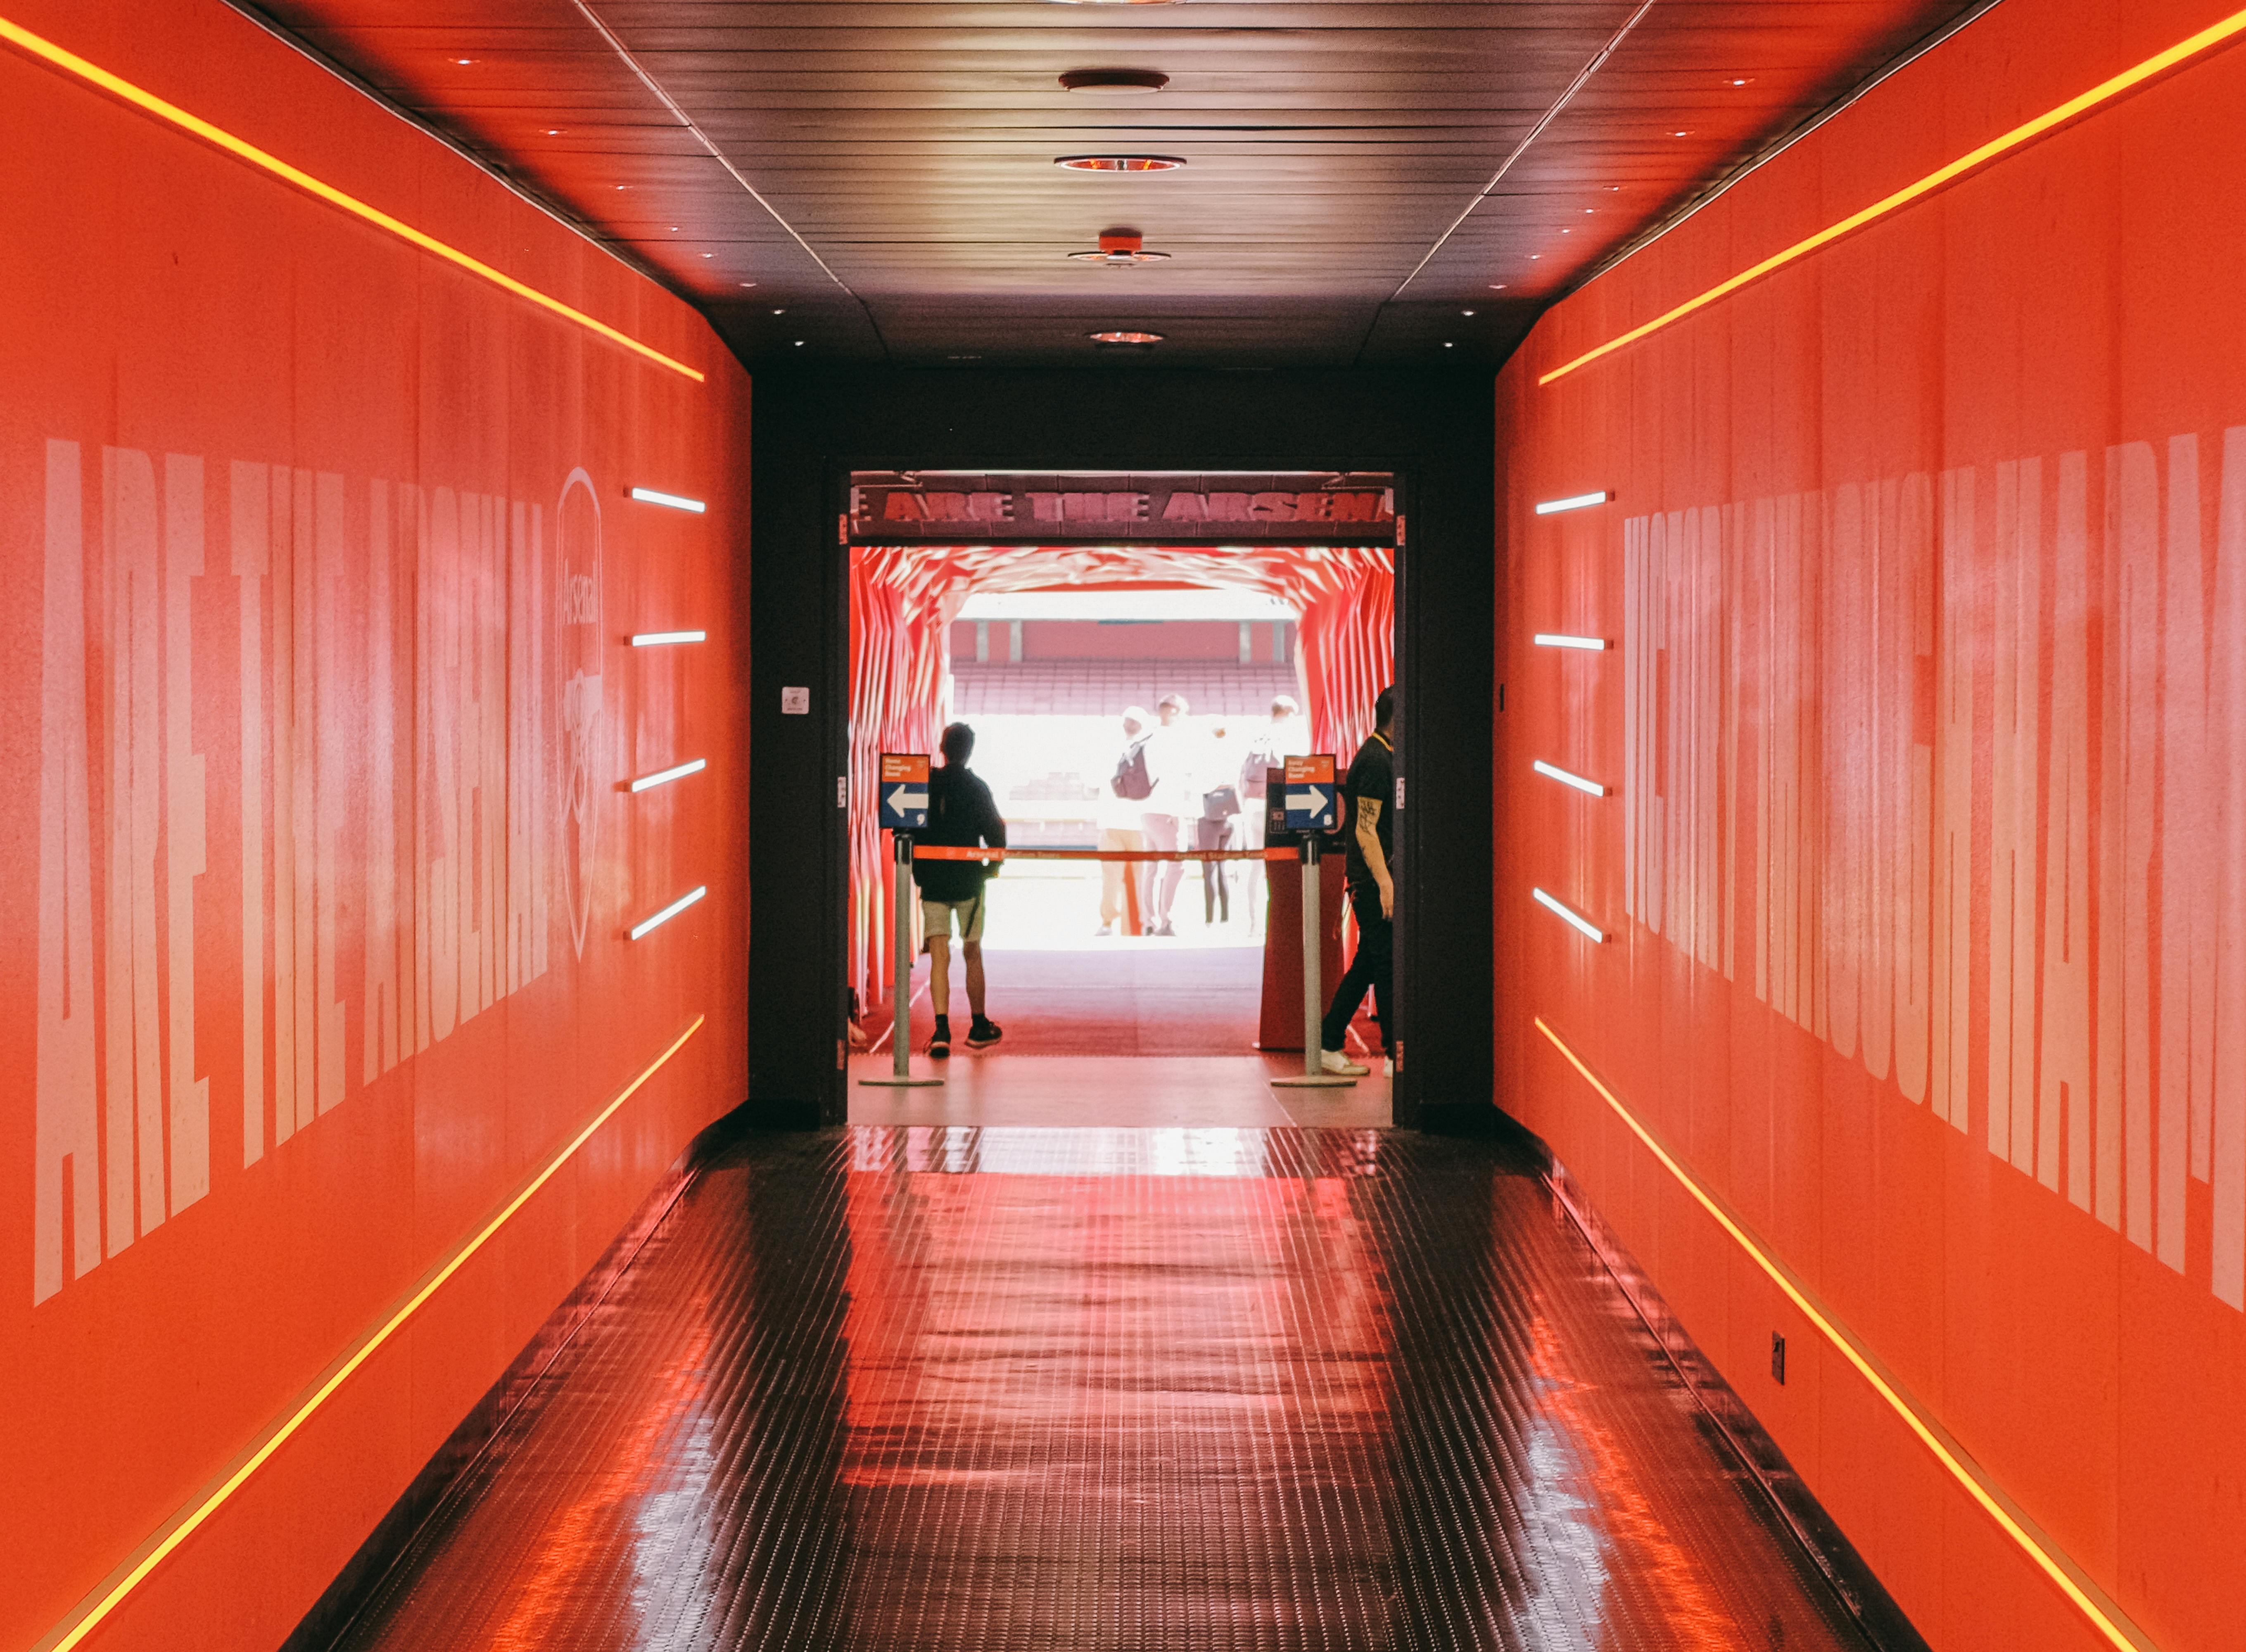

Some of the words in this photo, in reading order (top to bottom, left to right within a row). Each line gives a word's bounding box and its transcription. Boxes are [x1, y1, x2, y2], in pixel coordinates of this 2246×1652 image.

[562, 558, 599, 625] Arsenal
[883, 491, 1015, 522] ARE
[1025, 491, 1150, 522] THE
[33, 438, 209, 1308] ARE
[230, 459, 346, 1170] THE
[363, 477, 548, 1087] ARSENAL
[1625, 496, 1746, 983] VICTORY
[1753, 465, 1977, 1136] THROUGH
